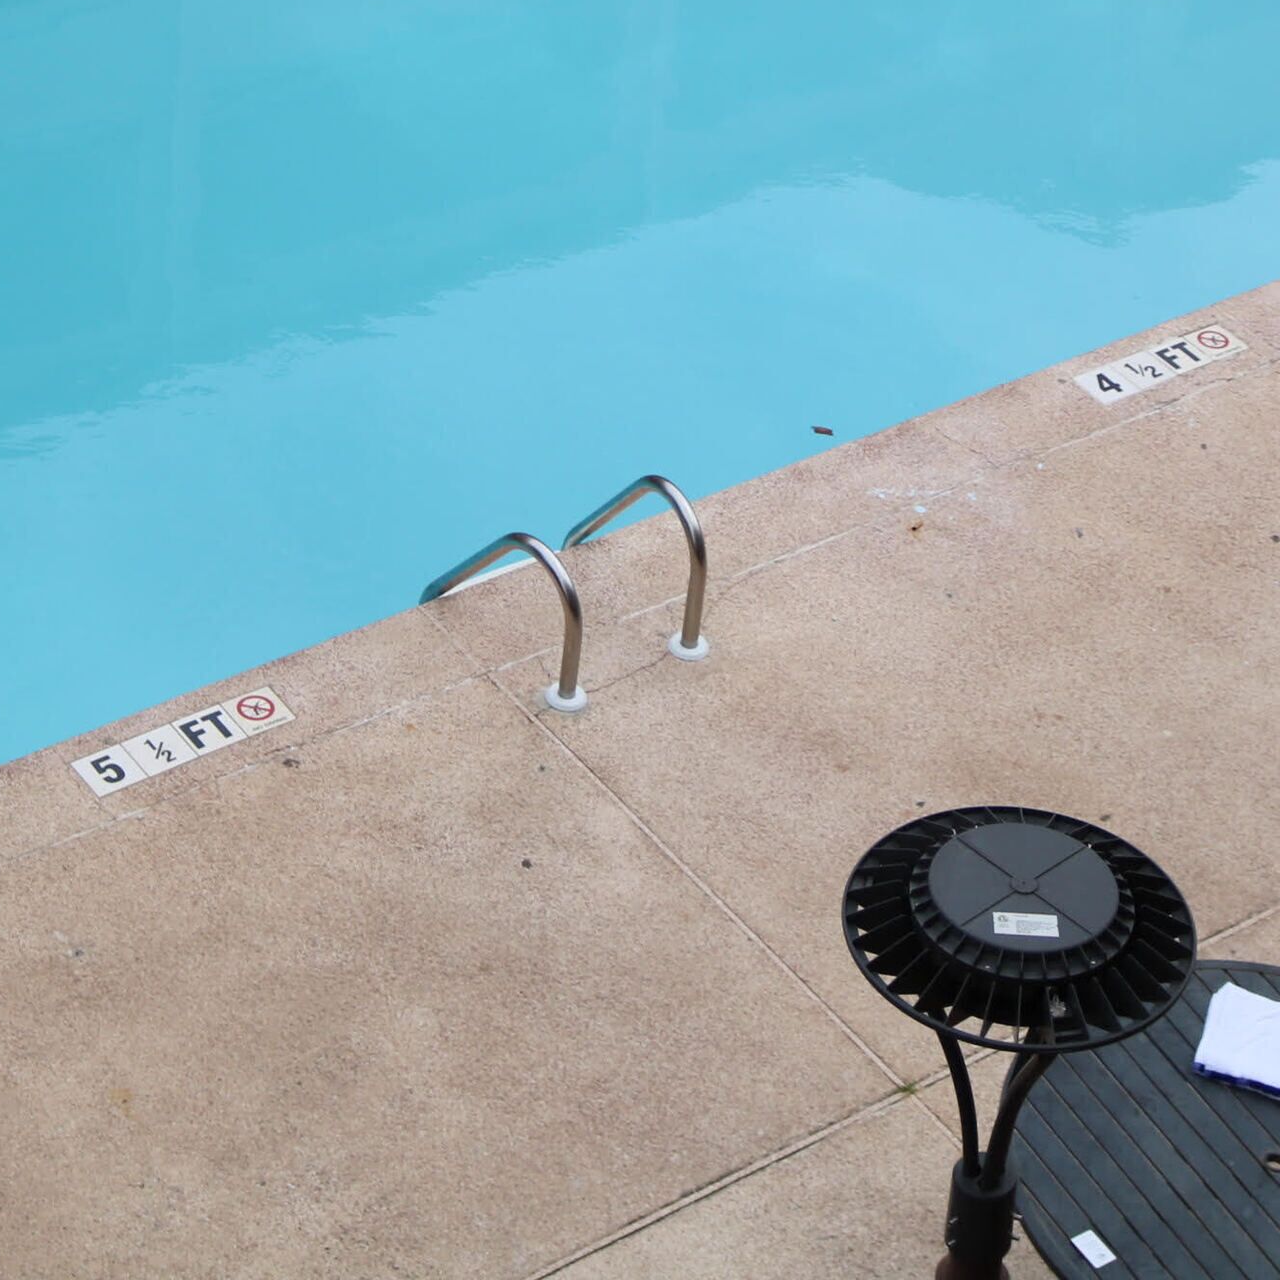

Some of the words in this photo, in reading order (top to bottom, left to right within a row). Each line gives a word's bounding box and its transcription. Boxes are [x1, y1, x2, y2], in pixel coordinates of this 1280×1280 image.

[1096, 372, 1123, 393] 4
[1155, 341, 1201, 370] FT
[90, 754, 126, 784] 5
[179, 710, 233, 749] FT
